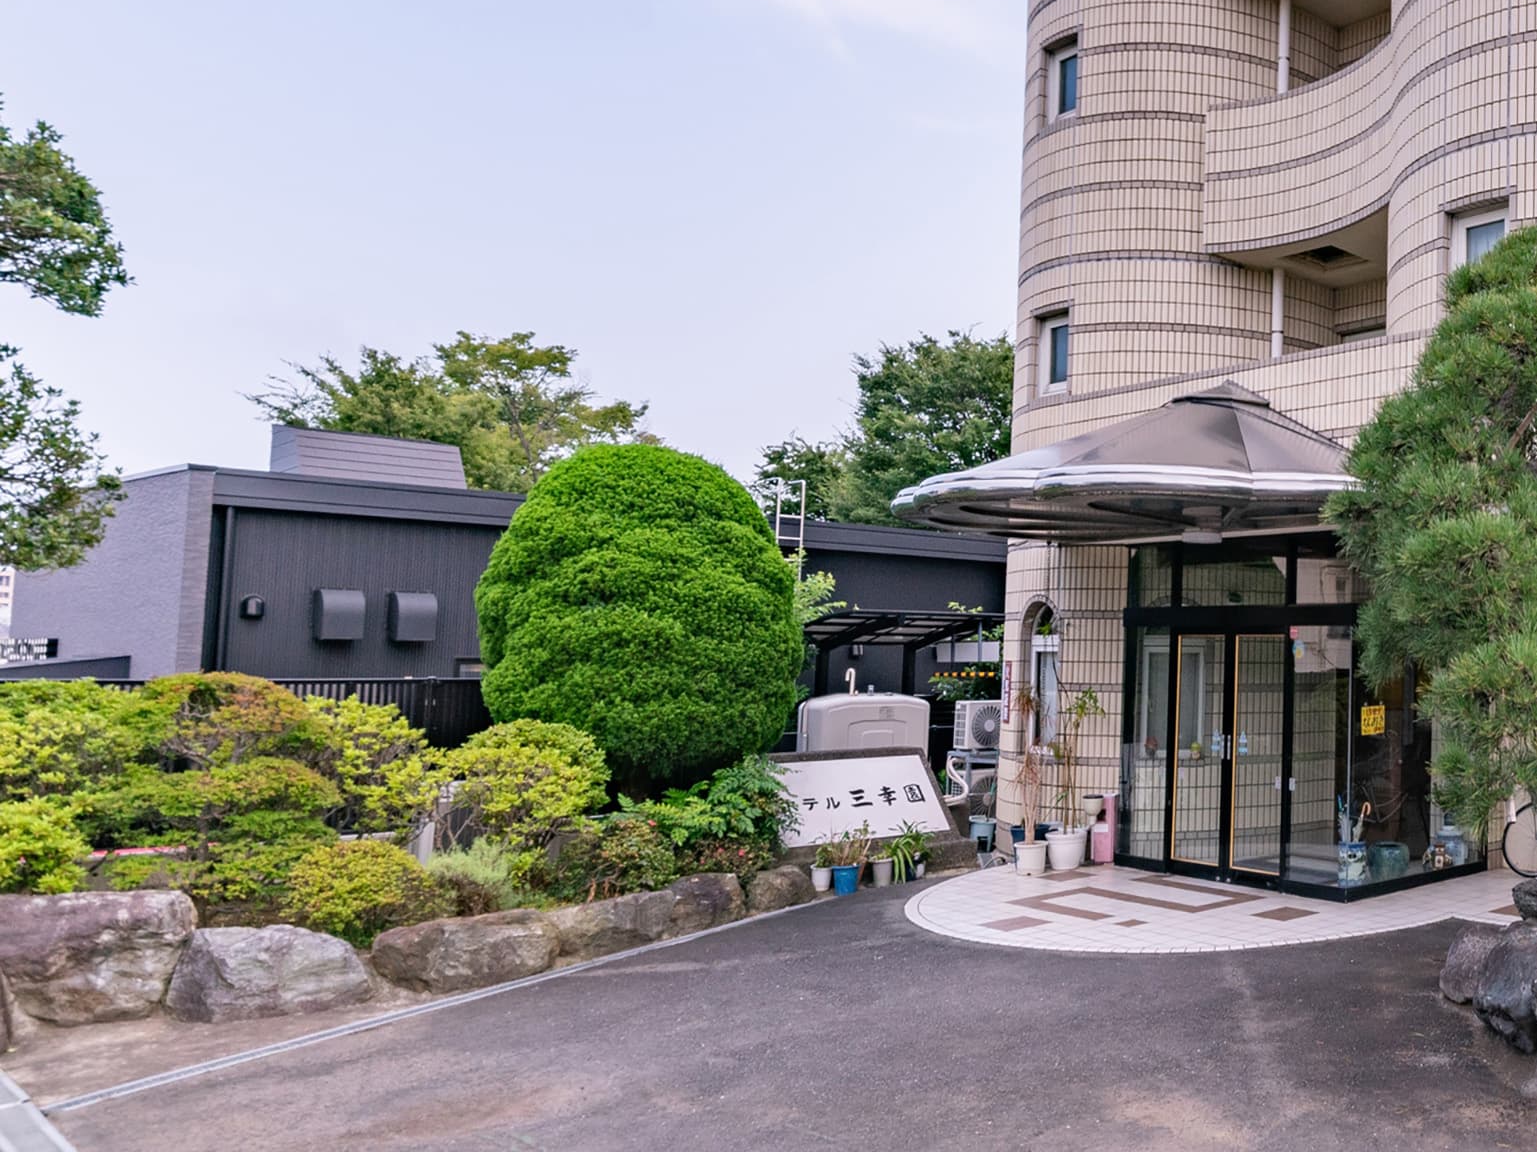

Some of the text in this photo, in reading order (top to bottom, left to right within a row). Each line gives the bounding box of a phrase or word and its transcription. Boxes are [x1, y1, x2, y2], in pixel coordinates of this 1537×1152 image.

[802, 784, 926, 811] テル三幸園
